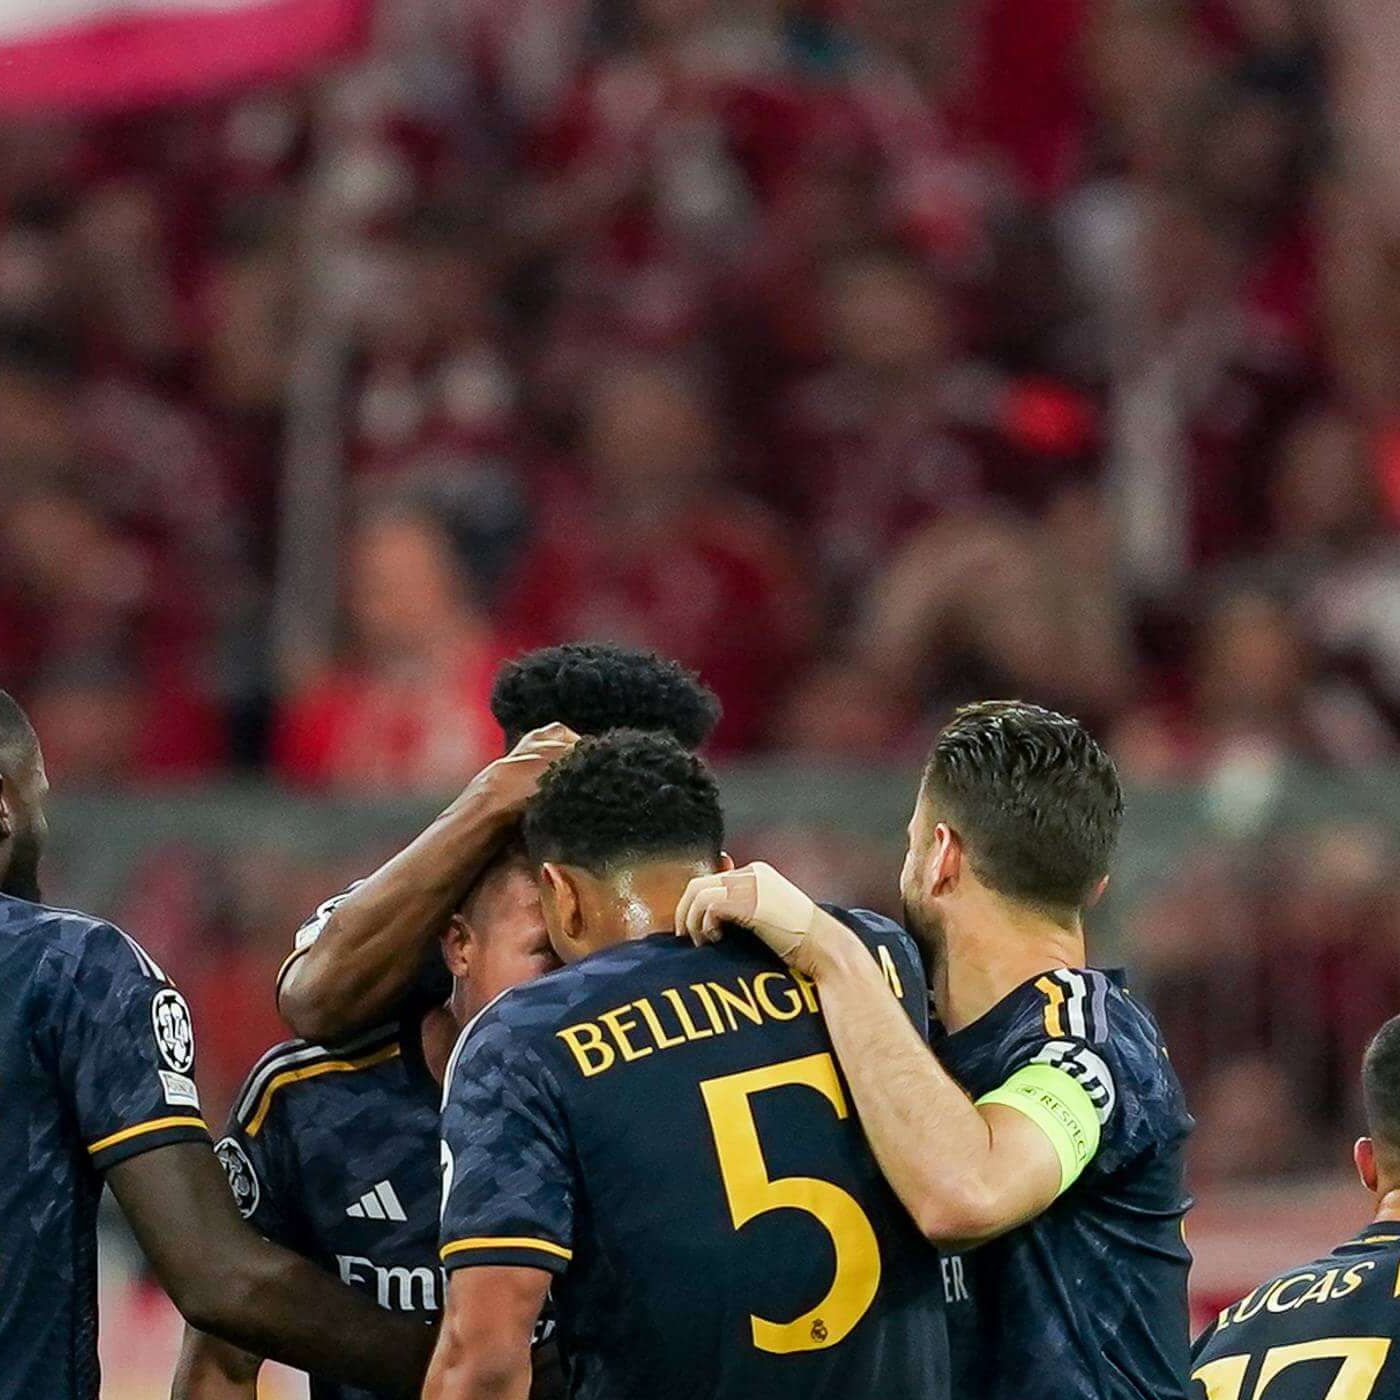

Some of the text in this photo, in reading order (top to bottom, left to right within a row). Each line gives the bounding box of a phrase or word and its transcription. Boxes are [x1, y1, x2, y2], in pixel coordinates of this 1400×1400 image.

[555, 944, 905, 1078] BELLING
[1040, 1095, 1090, 1162] RESPECT
[699, 1051, 882, 1355] 5
